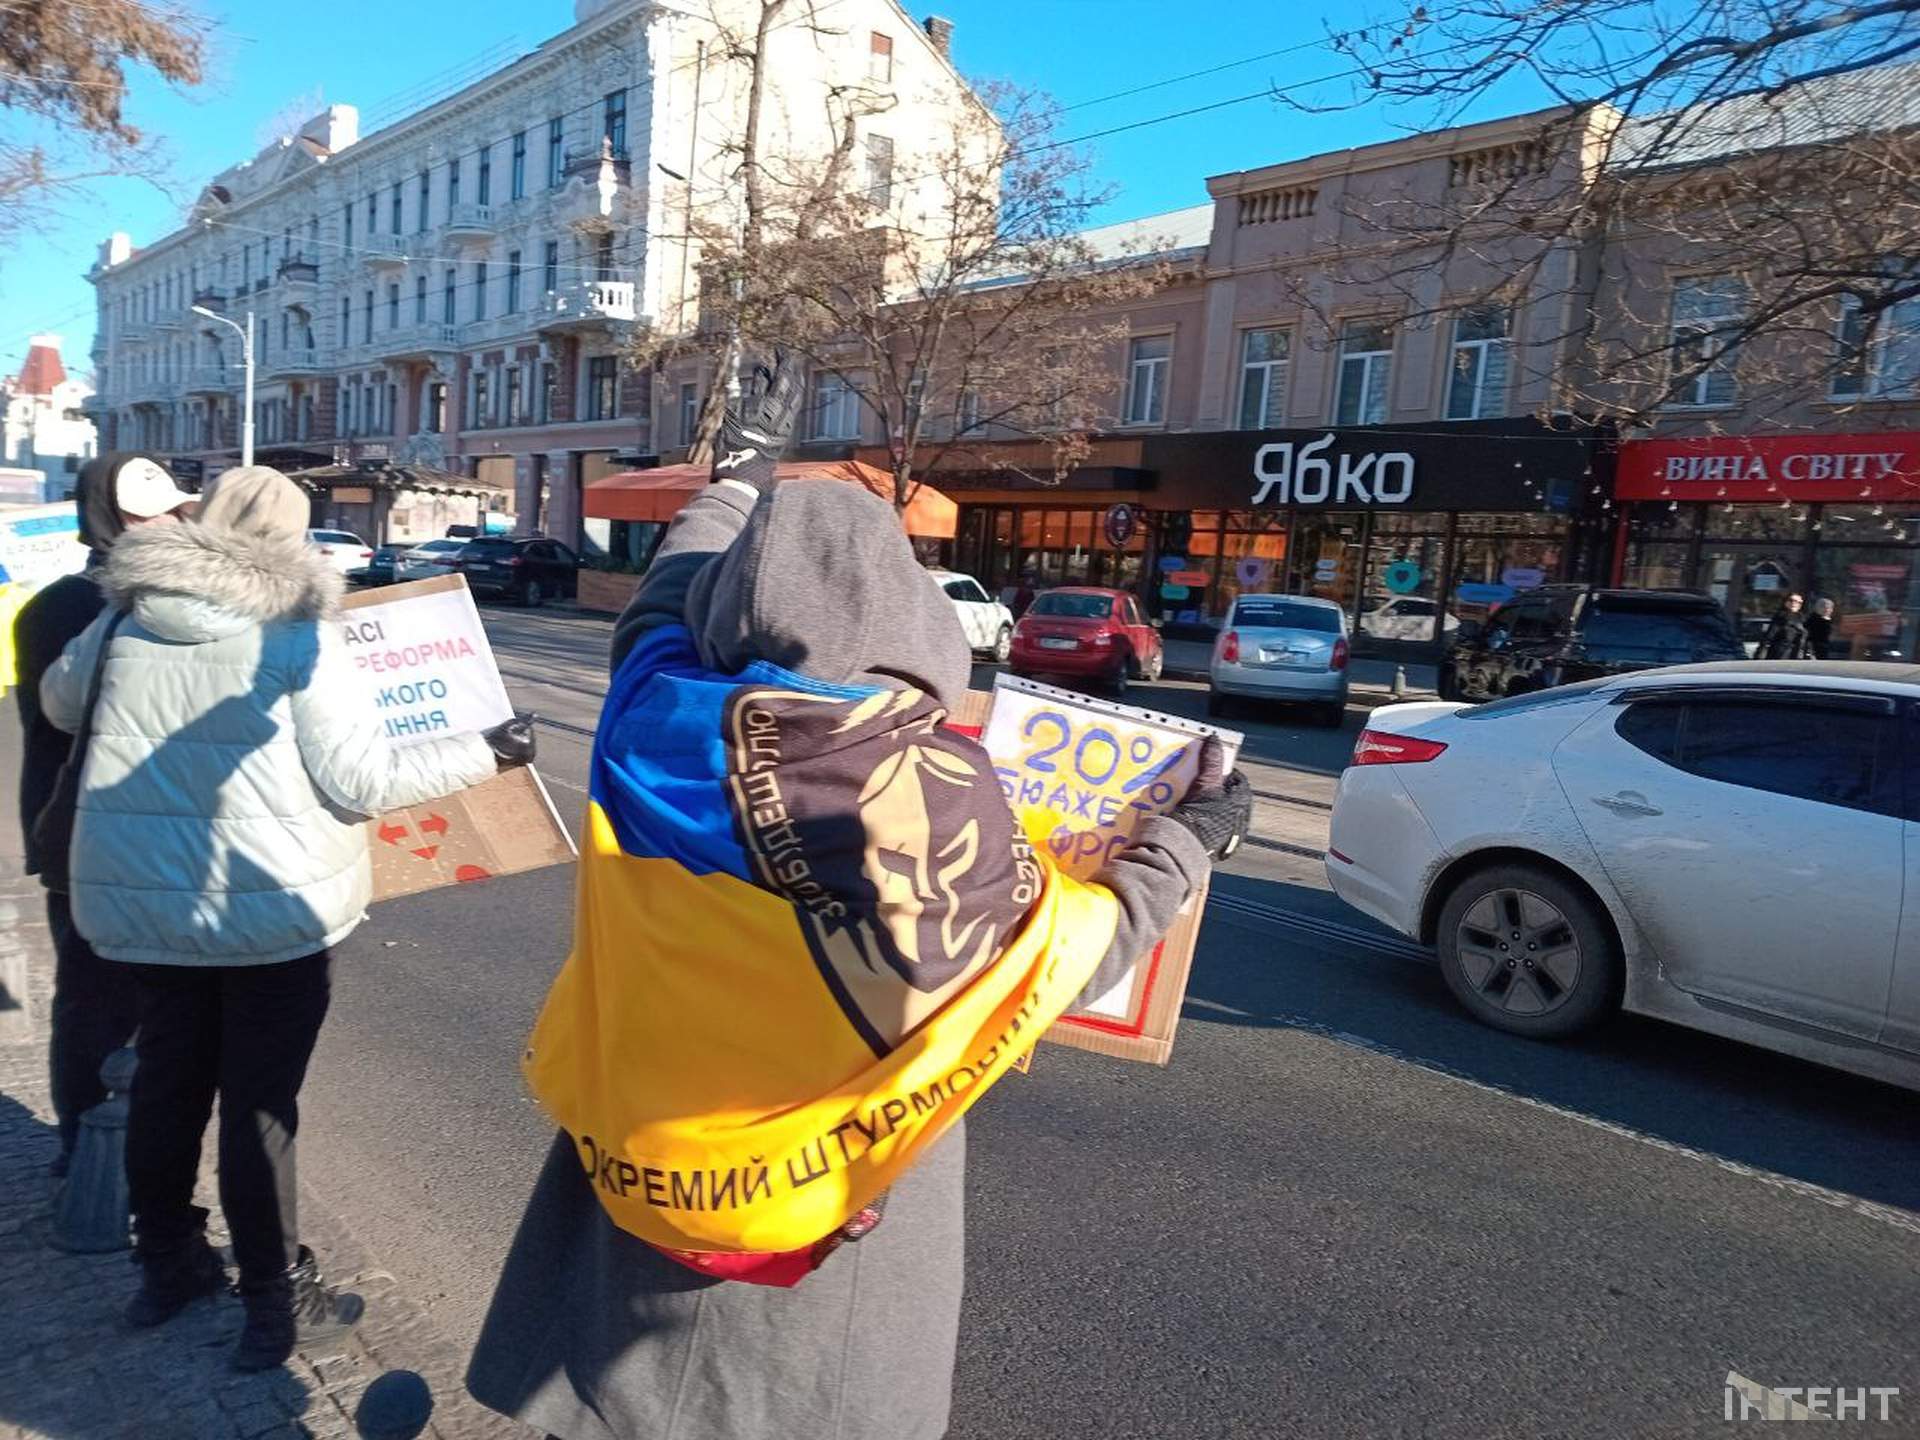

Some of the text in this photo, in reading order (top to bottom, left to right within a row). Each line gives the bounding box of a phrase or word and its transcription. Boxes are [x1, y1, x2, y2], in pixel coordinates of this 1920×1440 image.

[1251, 433, 1415, 504] Ябко
[1665, 453, 1904, 481] ВИНА СВІТУ
[1024, 711, 1186, 805] 20%
